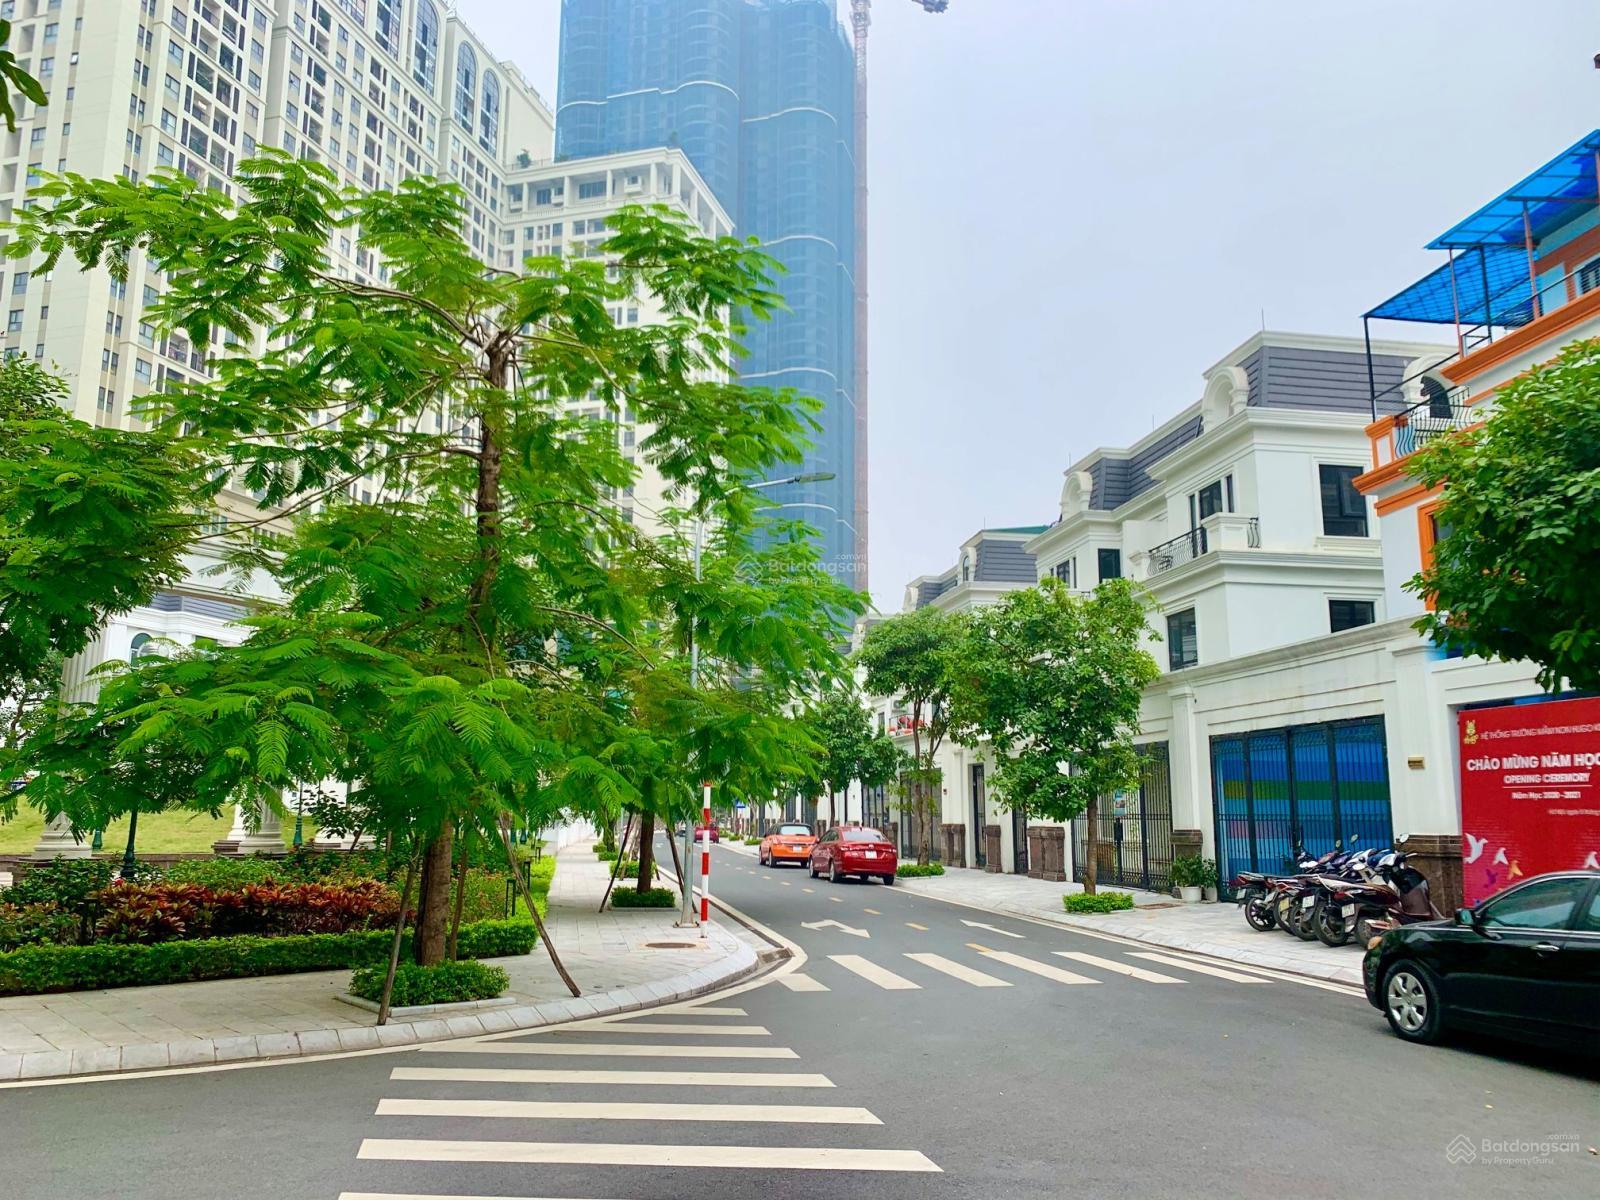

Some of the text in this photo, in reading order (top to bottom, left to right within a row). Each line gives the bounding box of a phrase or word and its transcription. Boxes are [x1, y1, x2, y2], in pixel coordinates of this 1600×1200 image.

[1466, 754, 1501, 771] CHÀO
[1502, 753, 1540, 769] MỪNG
[1541, 752, 1571, 768] NĂM
[1503, 772, 1591, 784] OPENING CEREMONY
